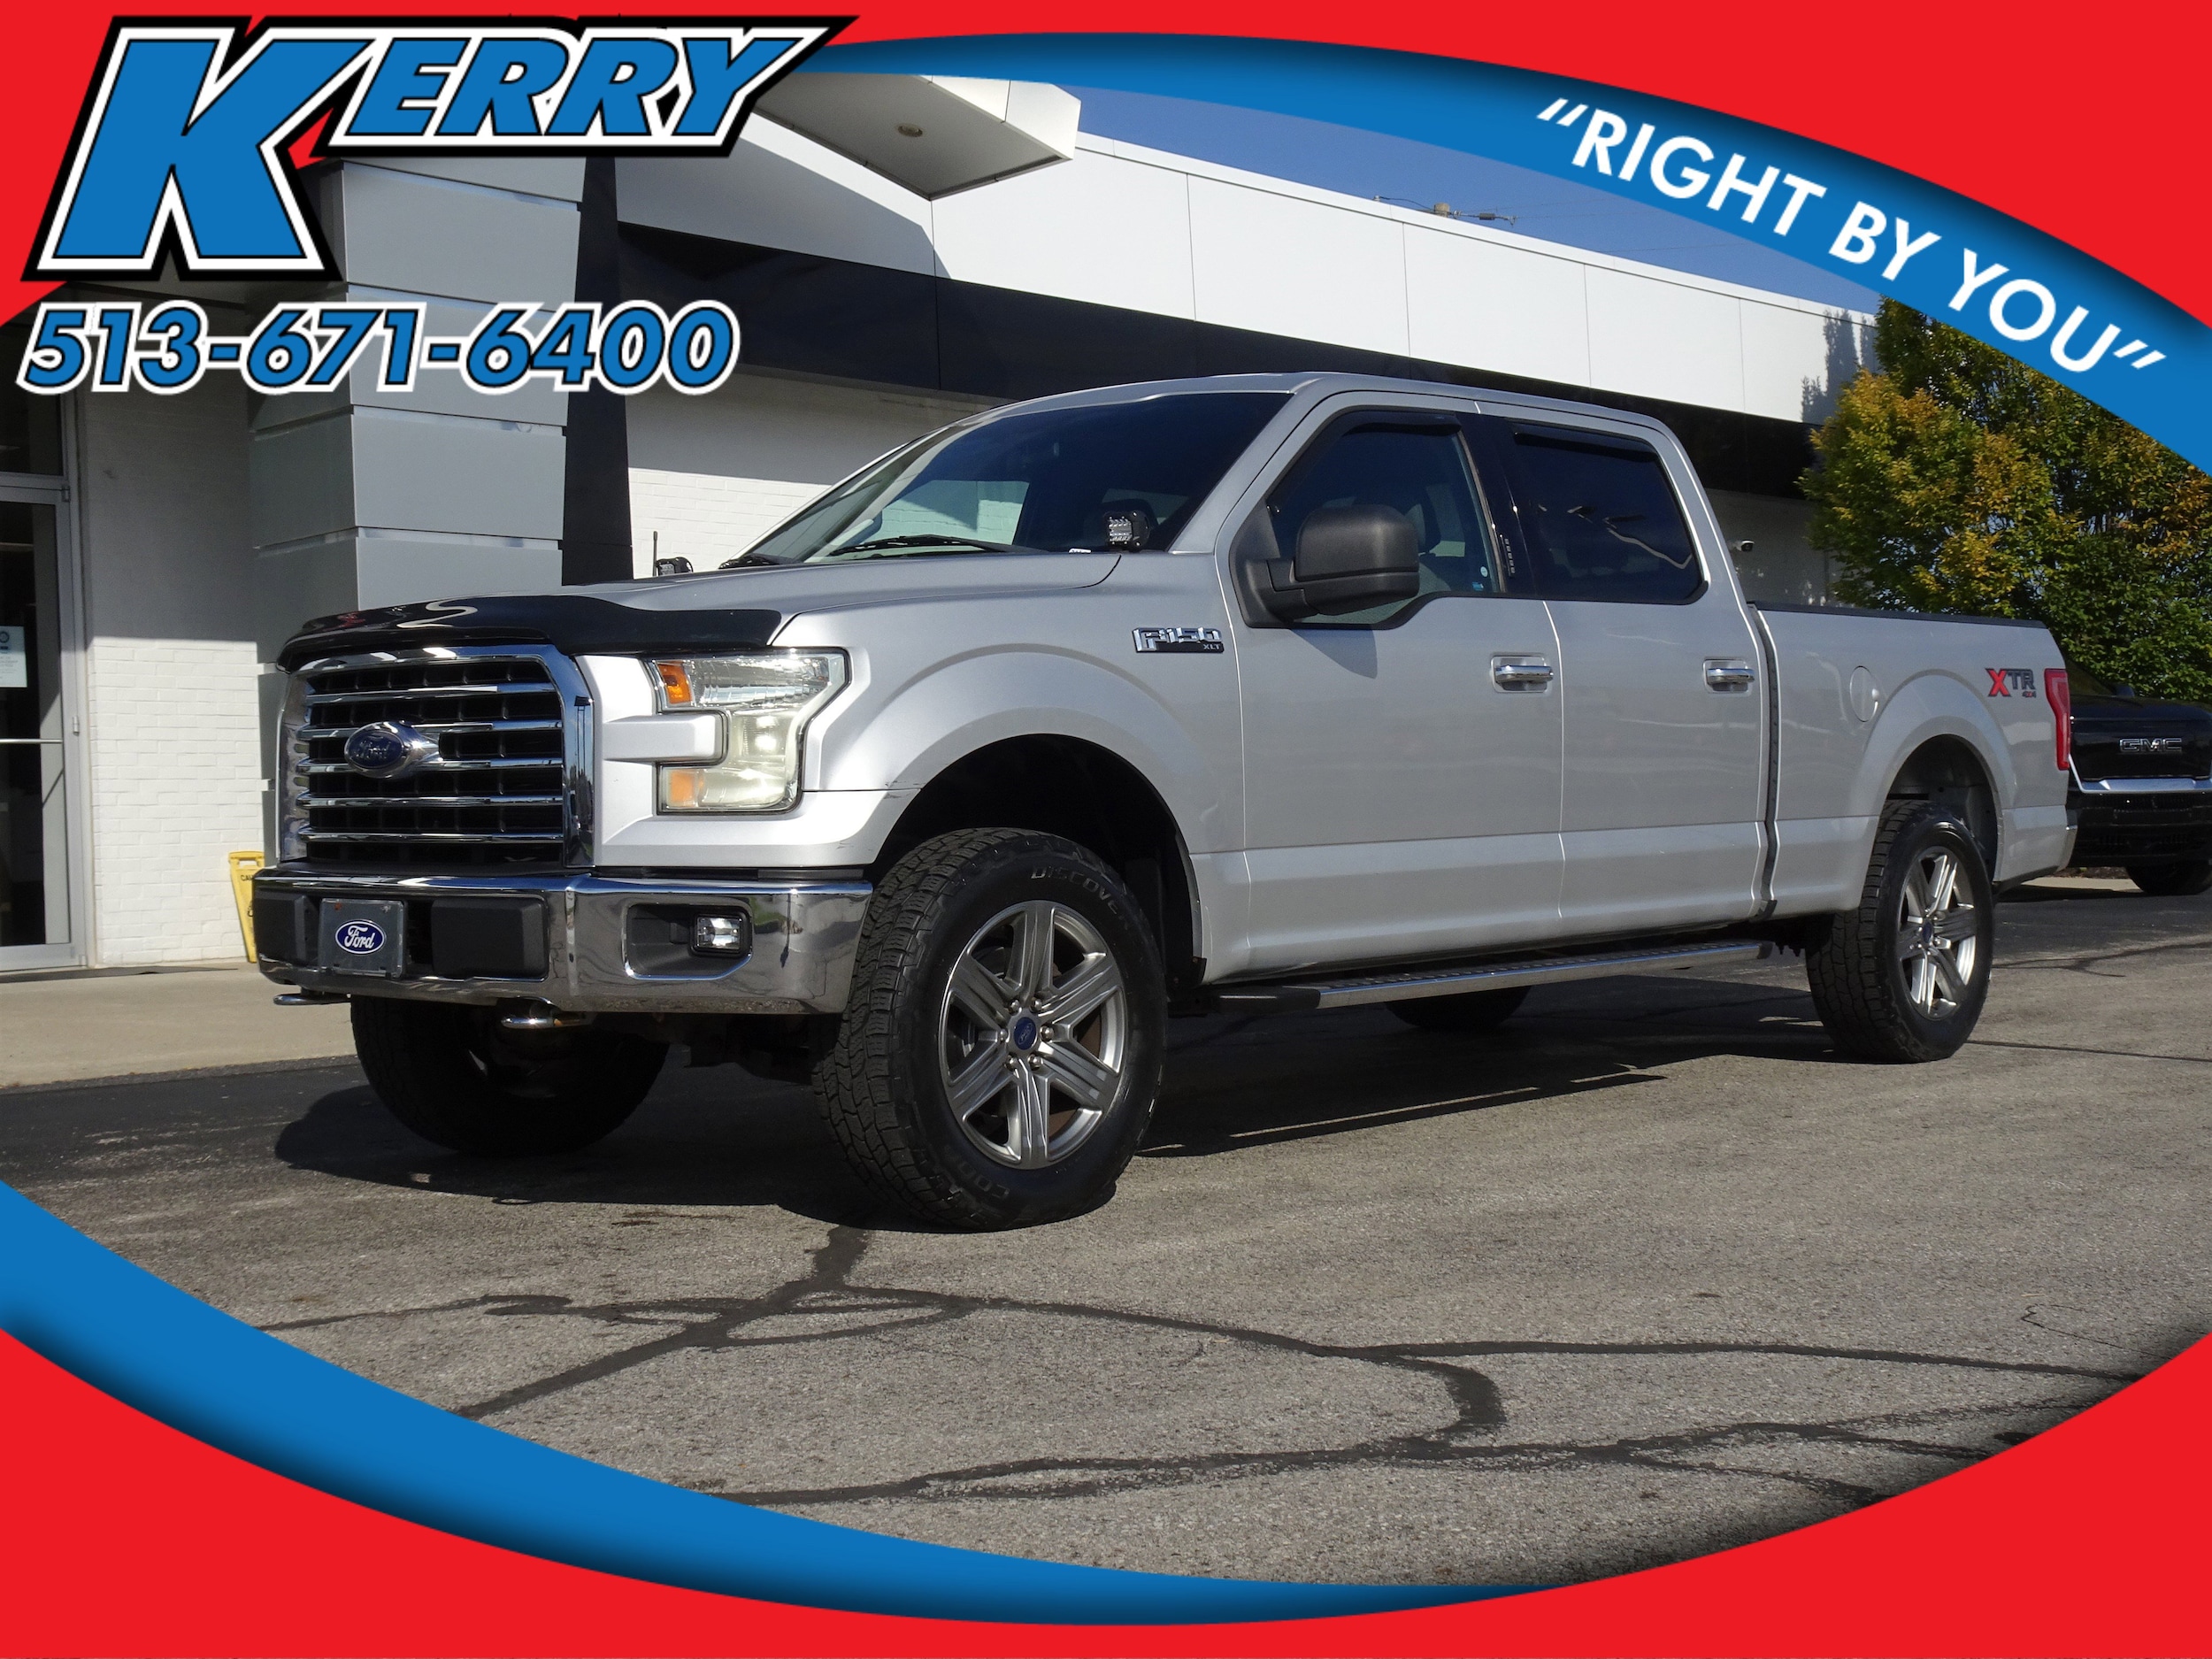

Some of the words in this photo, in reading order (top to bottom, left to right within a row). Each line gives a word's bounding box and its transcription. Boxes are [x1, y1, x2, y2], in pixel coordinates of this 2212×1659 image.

[1985, 668, 2036, 697] XTR
[2119, 738, 2183, 752] GMC
[343, 925, 376, 949] Ford
